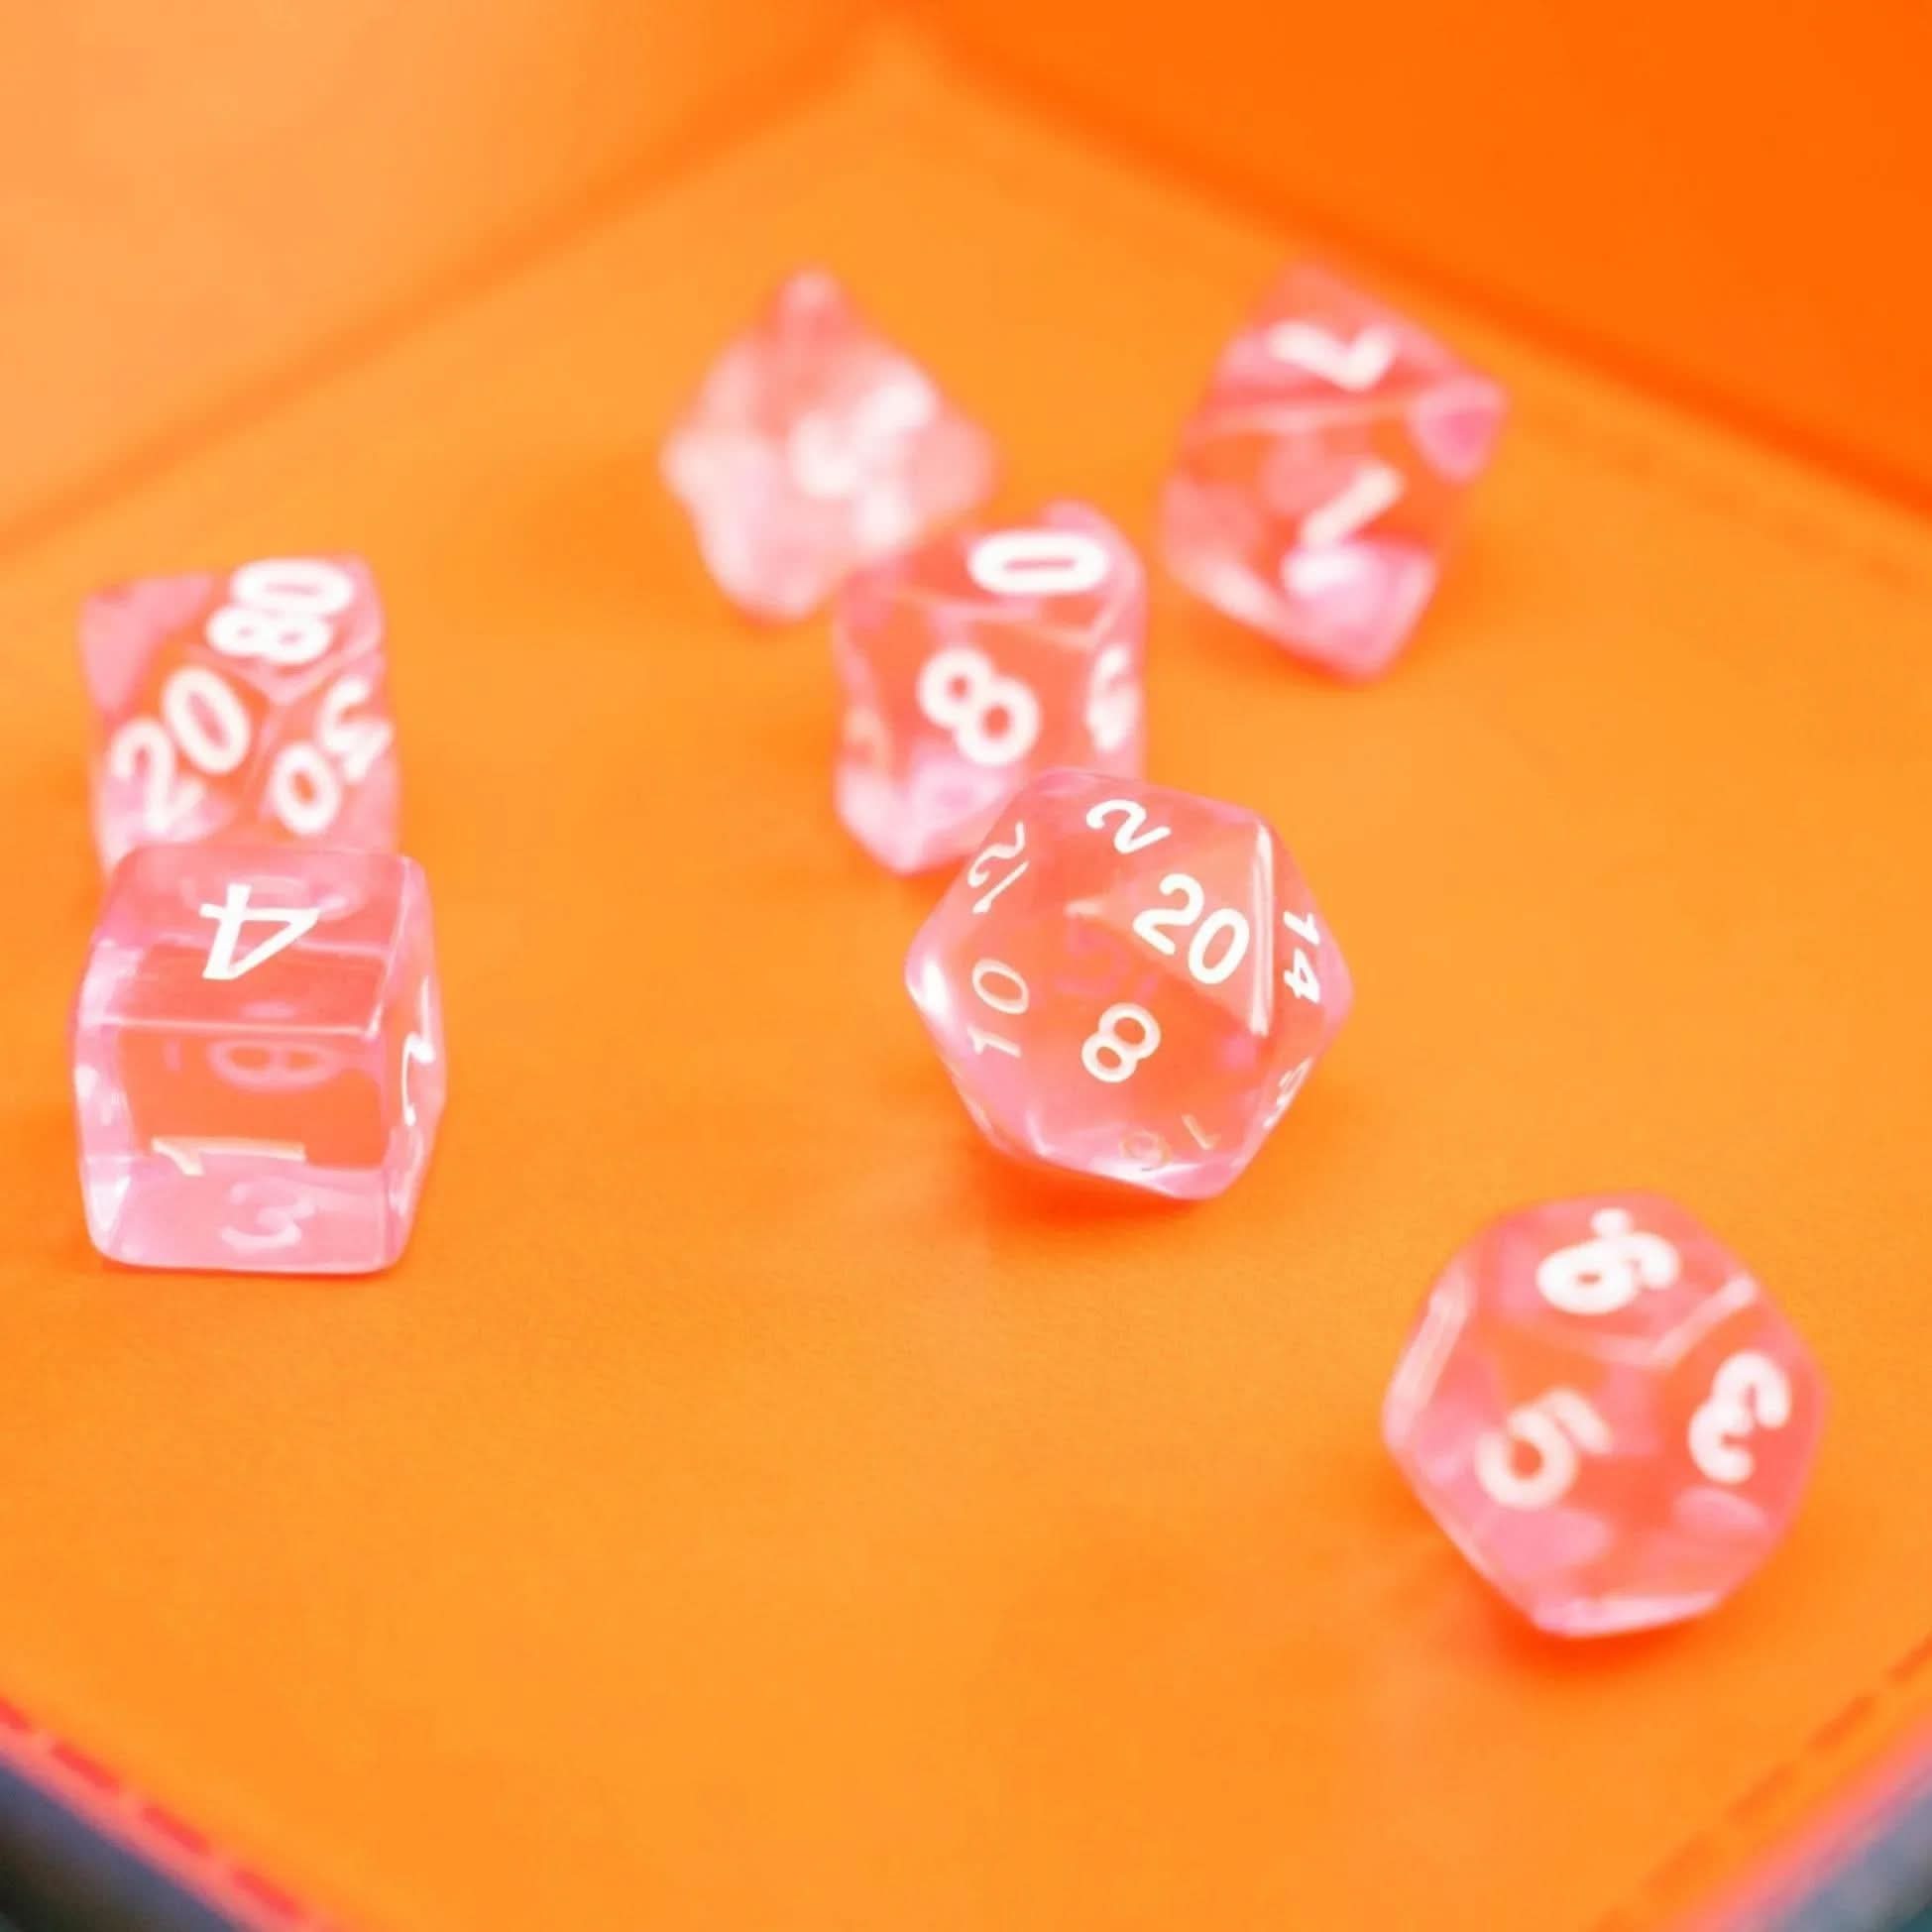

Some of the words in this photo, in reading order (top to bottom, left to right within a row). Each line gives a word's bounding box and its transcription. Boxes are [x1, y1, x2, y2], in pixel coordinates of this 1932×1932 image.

[206, 558, 354, 665] 80
[966, 527, 1108, 597] 0
[110, 664, 252, 836] 20
[917, 646, 1041, 766] 8
[1085, 798, 1173, 854] 2
[198, 882, 319, 981] 4
[1131, 872, 1251, 985] 20
[966, 957, 1030, 1059] 10
[1080, 1001, 1163, 1083] 8
[1475, 1387, 1614, 1511] 5
[1688, 1351, 1791, 1485] 3
